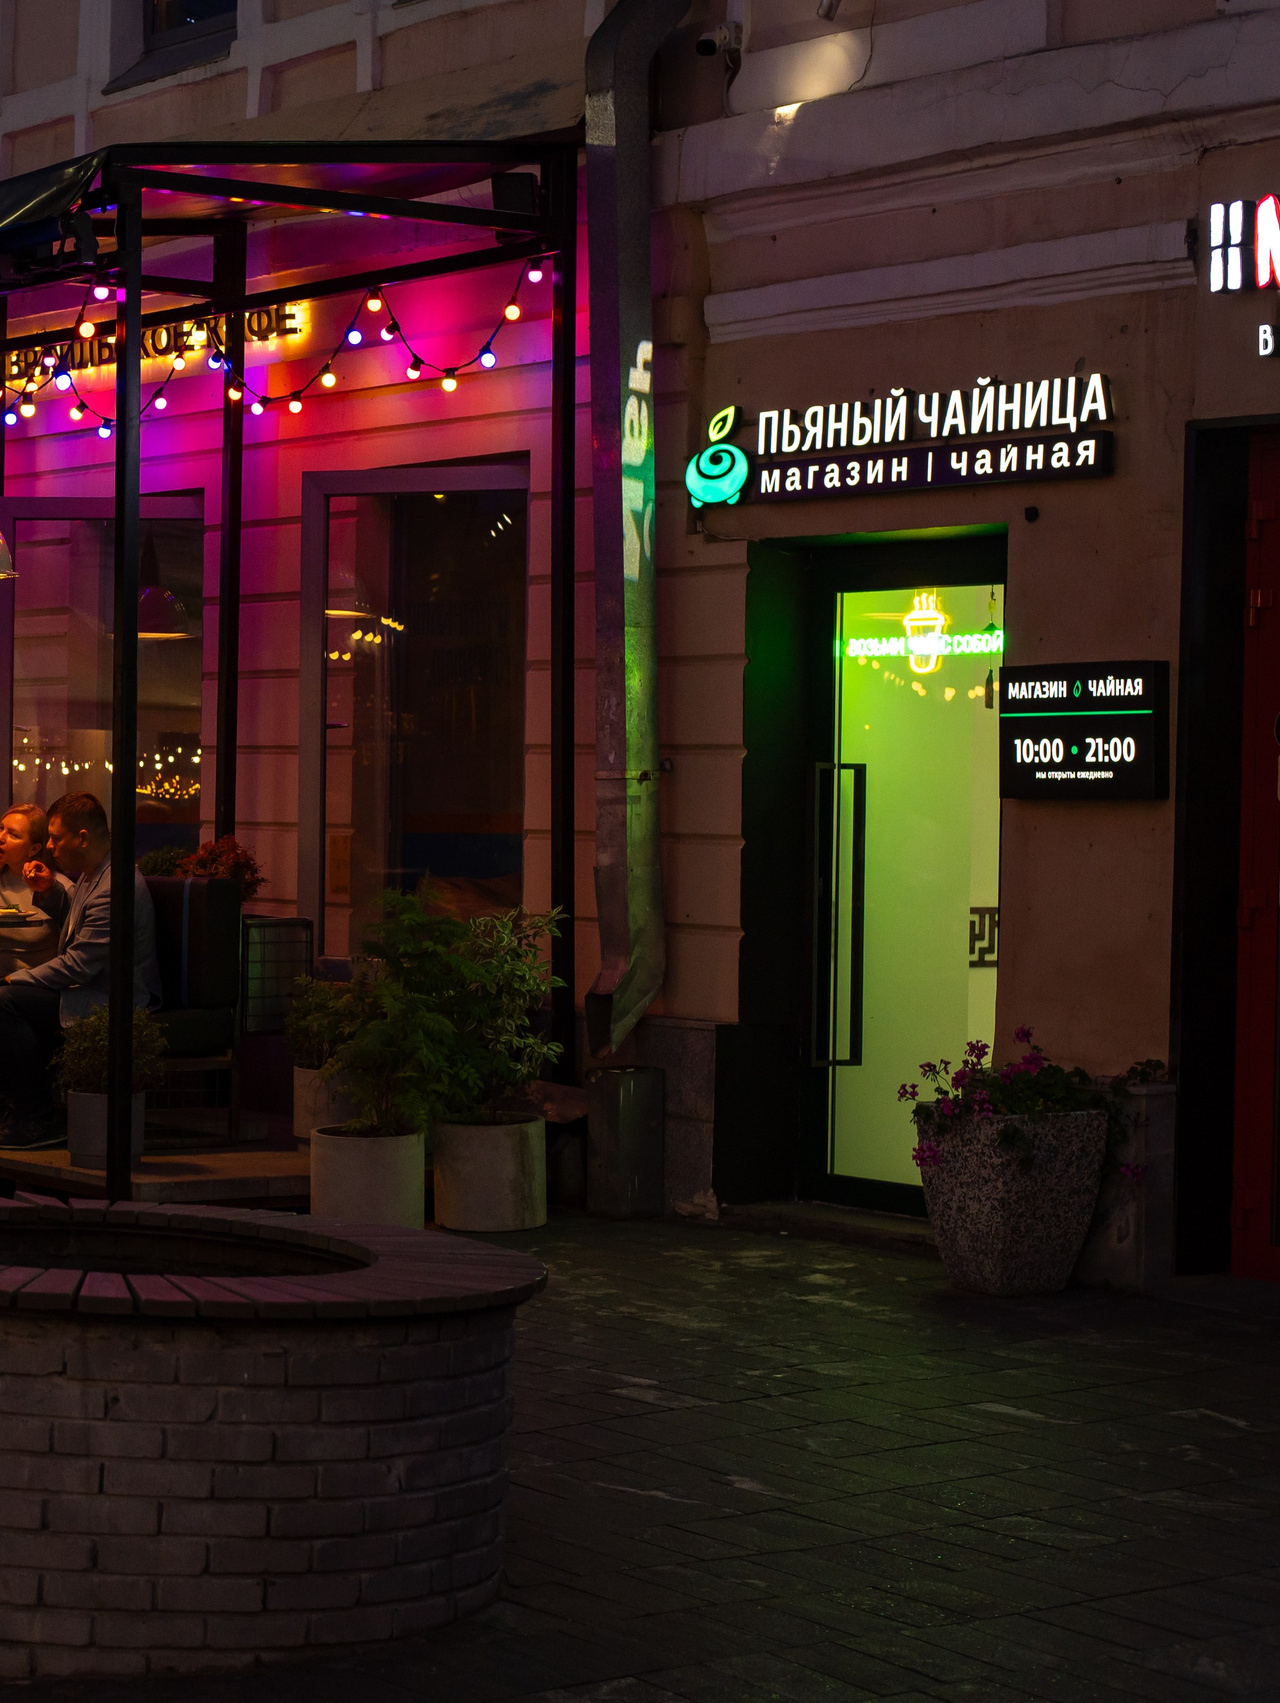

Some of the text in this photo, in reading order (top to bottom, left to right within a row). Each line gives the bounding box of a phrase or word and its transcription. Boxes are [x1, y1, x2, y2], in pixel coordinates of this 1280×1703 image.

[206, 304, 299, 348] КФЕ
[757, 372, 1109, 456] ПЬЯНЫЙ ЧАЙНИЦА
[760, 439, 1097, 494] магазин чайная
[848, 636, 905, 657] ВОЗЬМИ
[952, 630, 1004, 654] СОБОЙ
[1008, 675, 1143, 700] МАГАЗИН ЧАЙНАЯ
[1014, 736, 1136, 764] 10:00 21:00
[1035, 770, 1114, 781] мы открыты ежедневно
